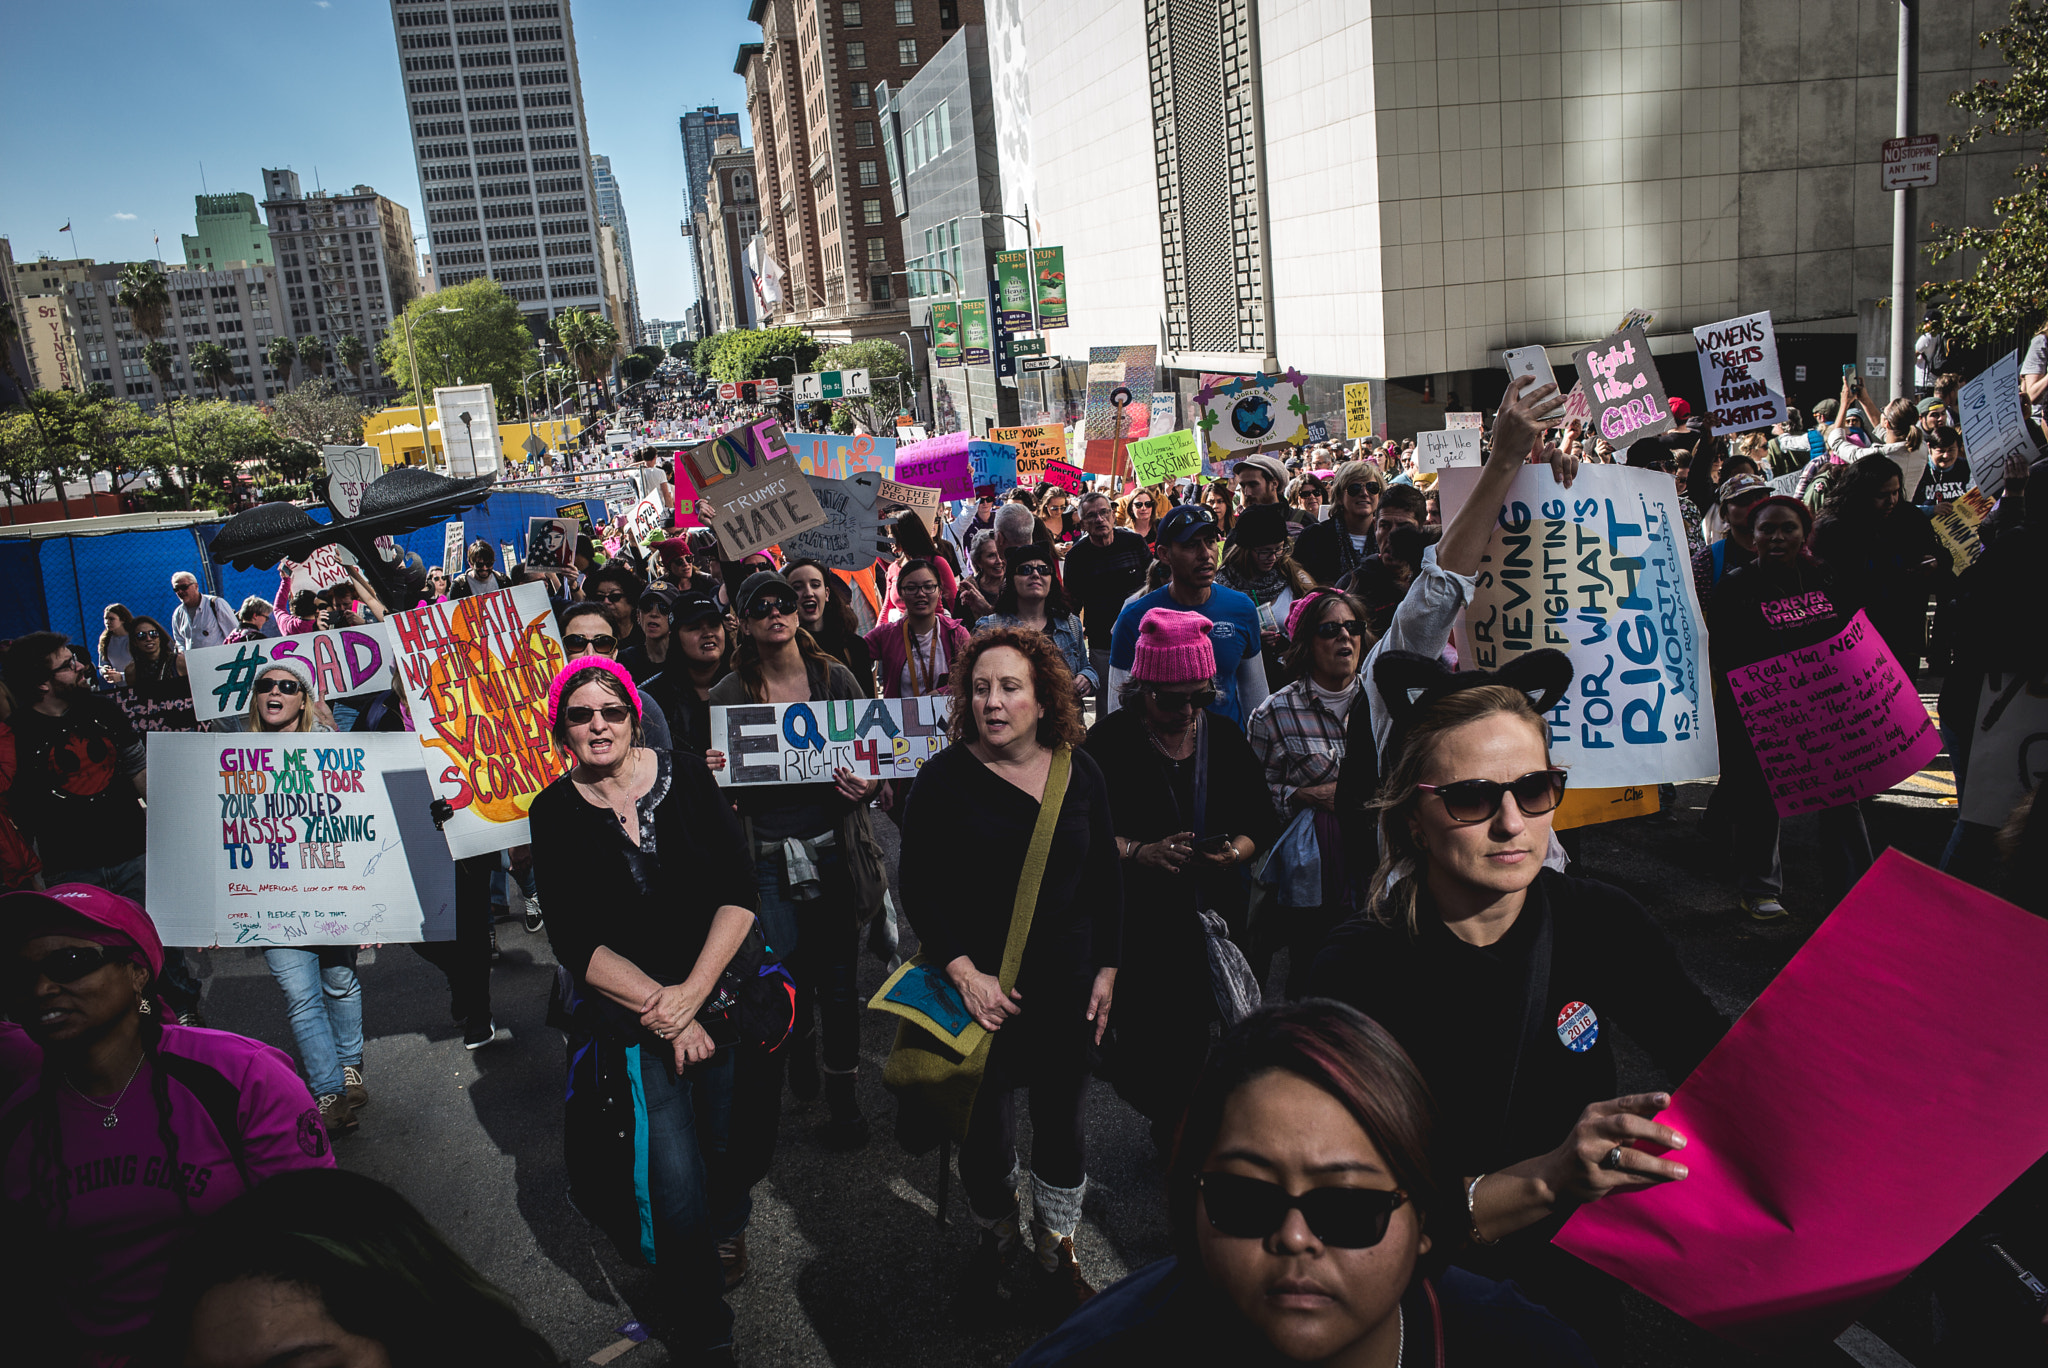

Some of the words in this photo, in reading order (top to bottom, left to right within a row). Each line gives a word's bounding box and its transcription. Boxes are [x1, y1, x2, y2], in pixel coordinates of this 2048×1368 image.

[1884, 148, 1900, 162] NO
[1901, 146, 1937, 160] STOPPING
[1911, 137, 1932, 145] AWAY
[1888, 164, 1907, 175] ANY
[1912, 161, 1932, 172] TIME
[999, 252, 1026, 263] SHEN
[1035, 249, 1056, 260] YUN
[208, 273, 242, 285] MART
[933, 304, 950, 312] YUN
[963, 301, 985, 310] SHEN
[994, 293, 1007, 372] PARKING
[1695, 319, 1765, 355] WOMEN'S
[1013, 343, 1028, 352] 5th
[1031, 343, 1040, 351] St
[1586, 339, 1636, 379] fight
[1709, 346, 1764, 369] RIGHTS
[1593, 376, 1633, 404] like
[1633, 372, 1648, 390] a
[1720, 364, 1751, 387] ARE
[797, 391, 820, 400] ONLY
[846, 386, 868, 395] ONLY
[1233, 389, 1260, 401] WORLD
[1354, 399, 1363, 407] I'M
[1714, 379, 1768, 406] HUMAN
[1351, 406, 1366, 414] WITH
[1600, 393, 1667, 440] GIRL
[1712, 400, 1777, 428] RIGHTS
[1992, 371, 2028, 460] APPRECIATE
[997, 430, 1018, 442] KEEP
[1021, 427, 1045, 437] YOUR
[1020, 439, 1039, 450] TINY
[1426, 433, 1449, 459] fight
[1454, 434, 1472, 448] like
[684, 417, 789, 489] LOVE
[1017, 458, 1039, 473] OUR
[1143, 451, 1201, 480] RESISTANCE
[1444, 450, 1466, 468] girl
[1964, 412, 2005, 494] HILLARY
[901, 460, 949, 480] EXPECT
[1046, 463, 1082, 480] Powerful
[339, 481, 360, 497] THIS
[723, 478, 787, 514] TRUMPS
[881, 482, 901, 493] WE
[906, 490, 930, 499] THE
[881, 491, 929, 505] PEOPLE
[1925, 481, 1963, 494] NASTY
[723, 490, 813, 551] HATE
[1936, 511, 1977, 545] HUMAN
[799, 530, 850, 552] MATTERS
[1655, 502, 1677, 581] CLINTON
[1542, 498, 1570, 645] FIGHTING
[1573, 497, 1613, 646] WHAT'S
[1760, 590, 1829, 616] FOREVER
[393, 603, 460, 654] HELL
[459, 588, 525, 639] HATH
[1604, 497, 1668, 745] RIGHT
[1656, 558, 1686, 696] WORTH
[1676, 583, 1692, 652] RODHAM
[401, 652, 432, 691] NO
[435, 635, 491, 686] FURY
[495, 623, 561, 670] LIKE
[1732, 677, 1743, 688] a
[1744, 660, 1788, 685] Real
[1785, 649, 1826, 668] Man
[212, 630, 383, 713] #SAD
[420, 678, 473, 723] 157
[1581, 654, 1615, 749] FOR
[1746, 700, 1788, 722] Expects
[1790, 699, 1802, 708] a
[1808, 682, 1851, 704] woman
[432, 703, 555, 763] WOMEN
[1674, 711, 1691, 742] IS
[1821, 716, 1846, 735] mad
[1848, 708, 1873, 726] when
[1825, 757, 1834, 766] a
[1884, 723, 1907, 743] body
[220, 748, 274, 772] GIVE
[284, 748, 307, 771] ME
[313, 747, 366, 772] YOUR
[785, 745, 855, 782] RIGHTS
[219, 770, 267, 795] TIRED
[271, 770, 317, 794] YOUR
[322, 770, 366, 794] POOR
[218, 793, 260, 819] YOUR
[264, 792, 342, 818] HUDDLED
[222, 816, 298, 844] MASSES
[301, 814, 377, 844] YEARNING
[223, 842, 254, 870] TO
[269, 842, 290, 870] BE
[298, 841, 346, 870] FREE
[228, 882, 252, 893] REAL
[258, 884, 299, 893] AMERICANS
[257, 910, 261, 919] I
[267, 910, 297, 919] PLEDGE
[315, 910, 325, 918] DO
[1559, 1017, 1577, 1036] OXFORD
[1574, 1005, 1592, 1023] COMMA
[1568, 1015, 1592, 1041] 2016
